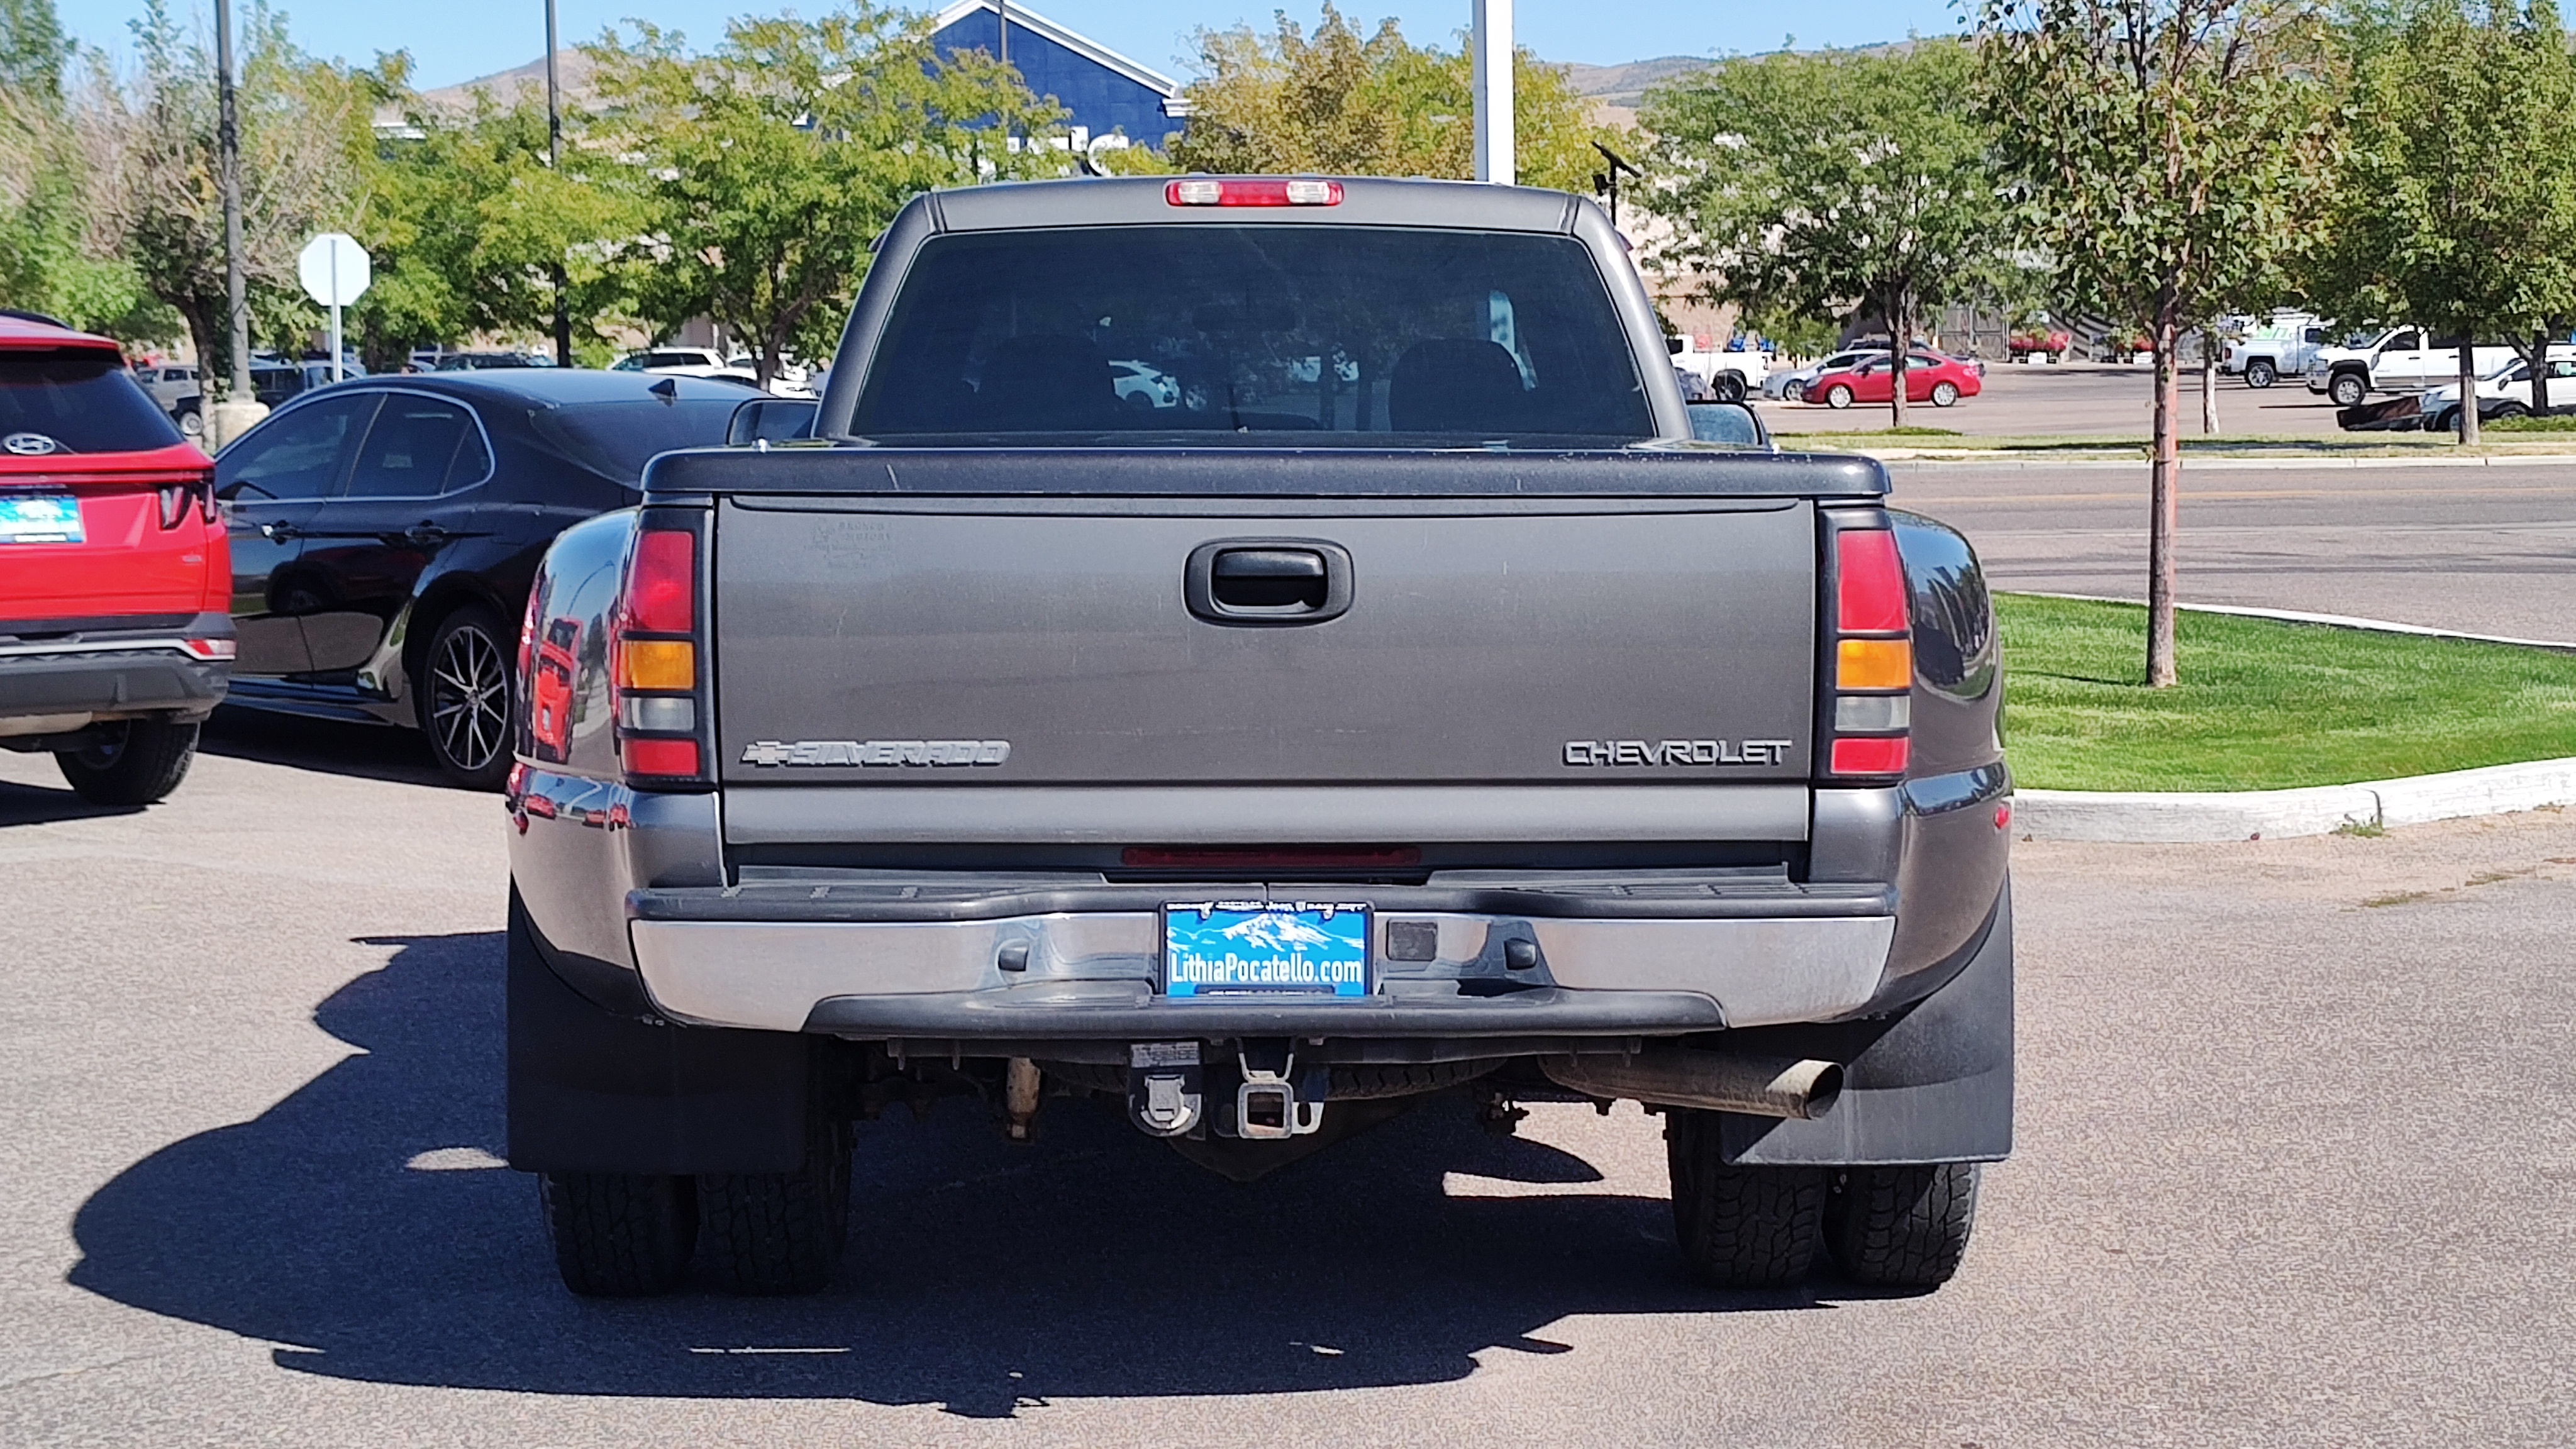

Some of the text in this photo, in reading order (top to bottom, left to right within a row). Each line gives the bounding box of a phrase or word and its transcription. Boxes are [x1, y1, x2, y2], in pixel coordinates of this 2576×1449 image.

[789, 741, 1011, 764] SILVERADO
[1564, 740, 1792, 763] CHEVROLET
[1170, 952, 1362, 982] LithiaPocatello.com
